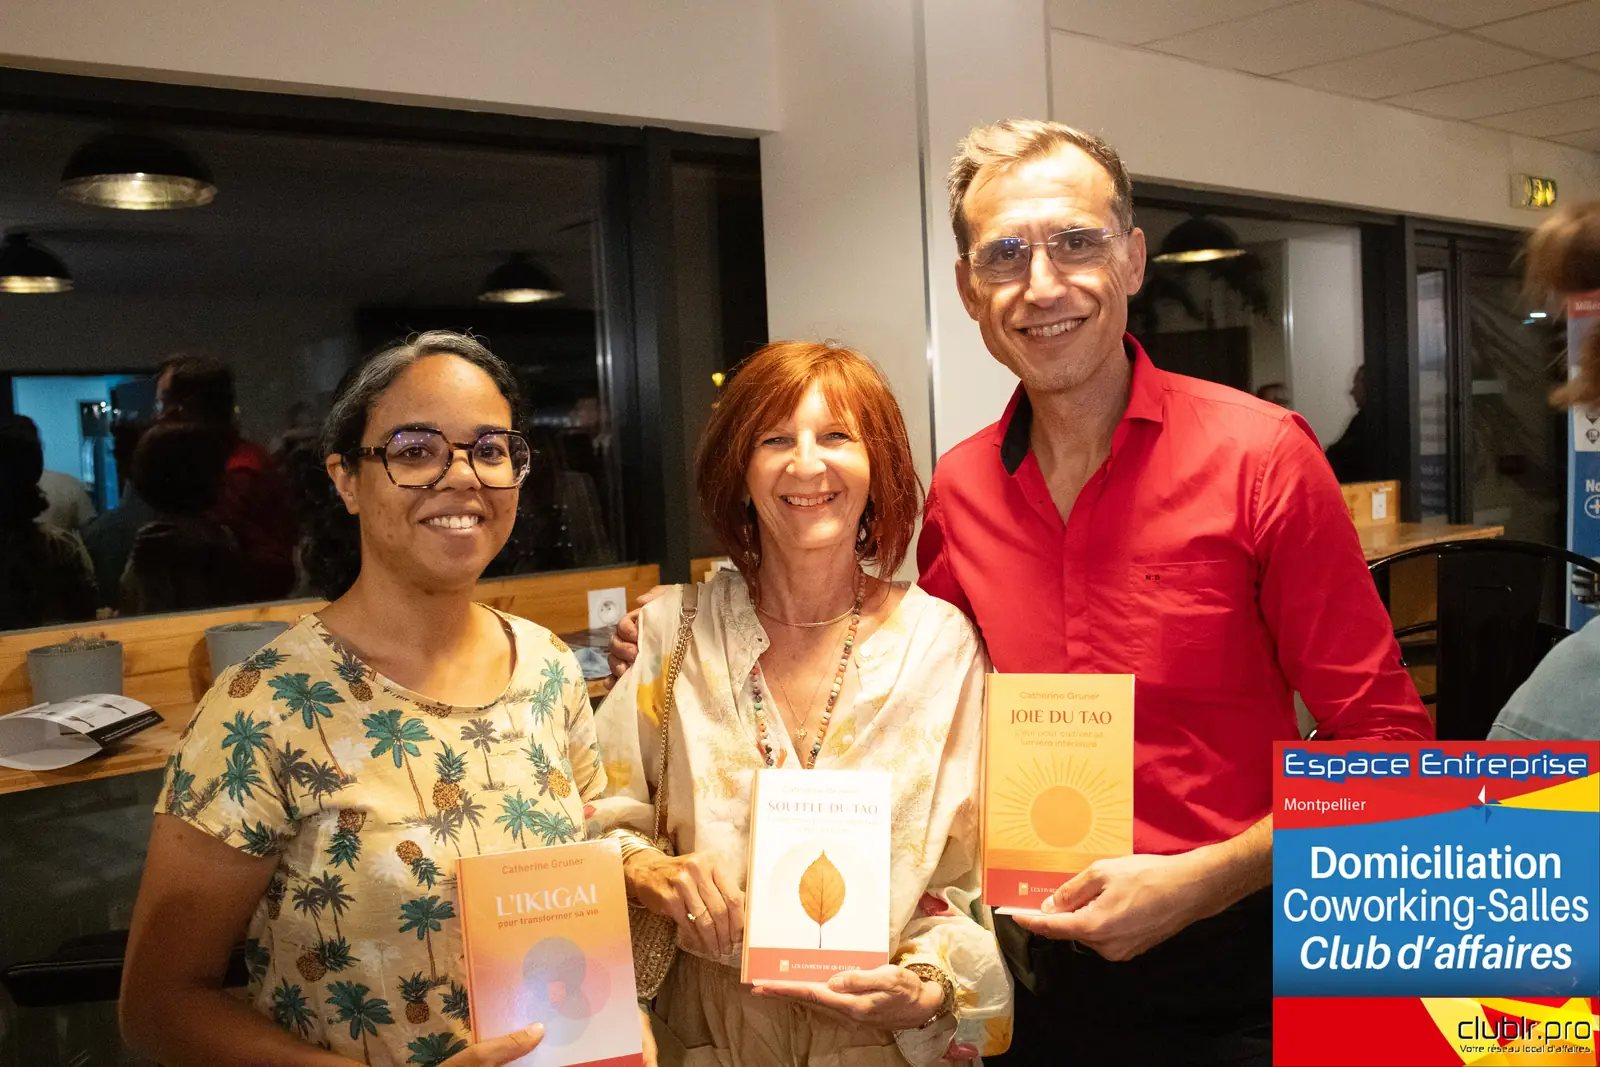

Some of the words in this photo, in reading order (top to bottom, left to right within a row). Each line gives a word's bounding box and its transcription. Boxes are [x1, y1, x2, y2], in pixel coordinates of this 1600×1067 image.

[1019, 691, 1065, 700] Catherine
[1067, 692, 1100, 700] Gruner
[1011, 709, 1044, 725] JOIE
[1050, 710, 1074, 724] DU
[1079, 711, 1112, 725] TAO
[1037, 731, 1057, 740] pour
[853, 803, 879, 815] TAO
[502, 861, 549, 875] Catherine
[551, 857, 584, 869] Gruner
[495, 883, 599, 917] L'IKIGAI
[498, 918, 519, 930] pour
[520, 911, 573, 925] transformer
[574, 910, 586, 919] sa
[586, 908, 599, 917] vie
